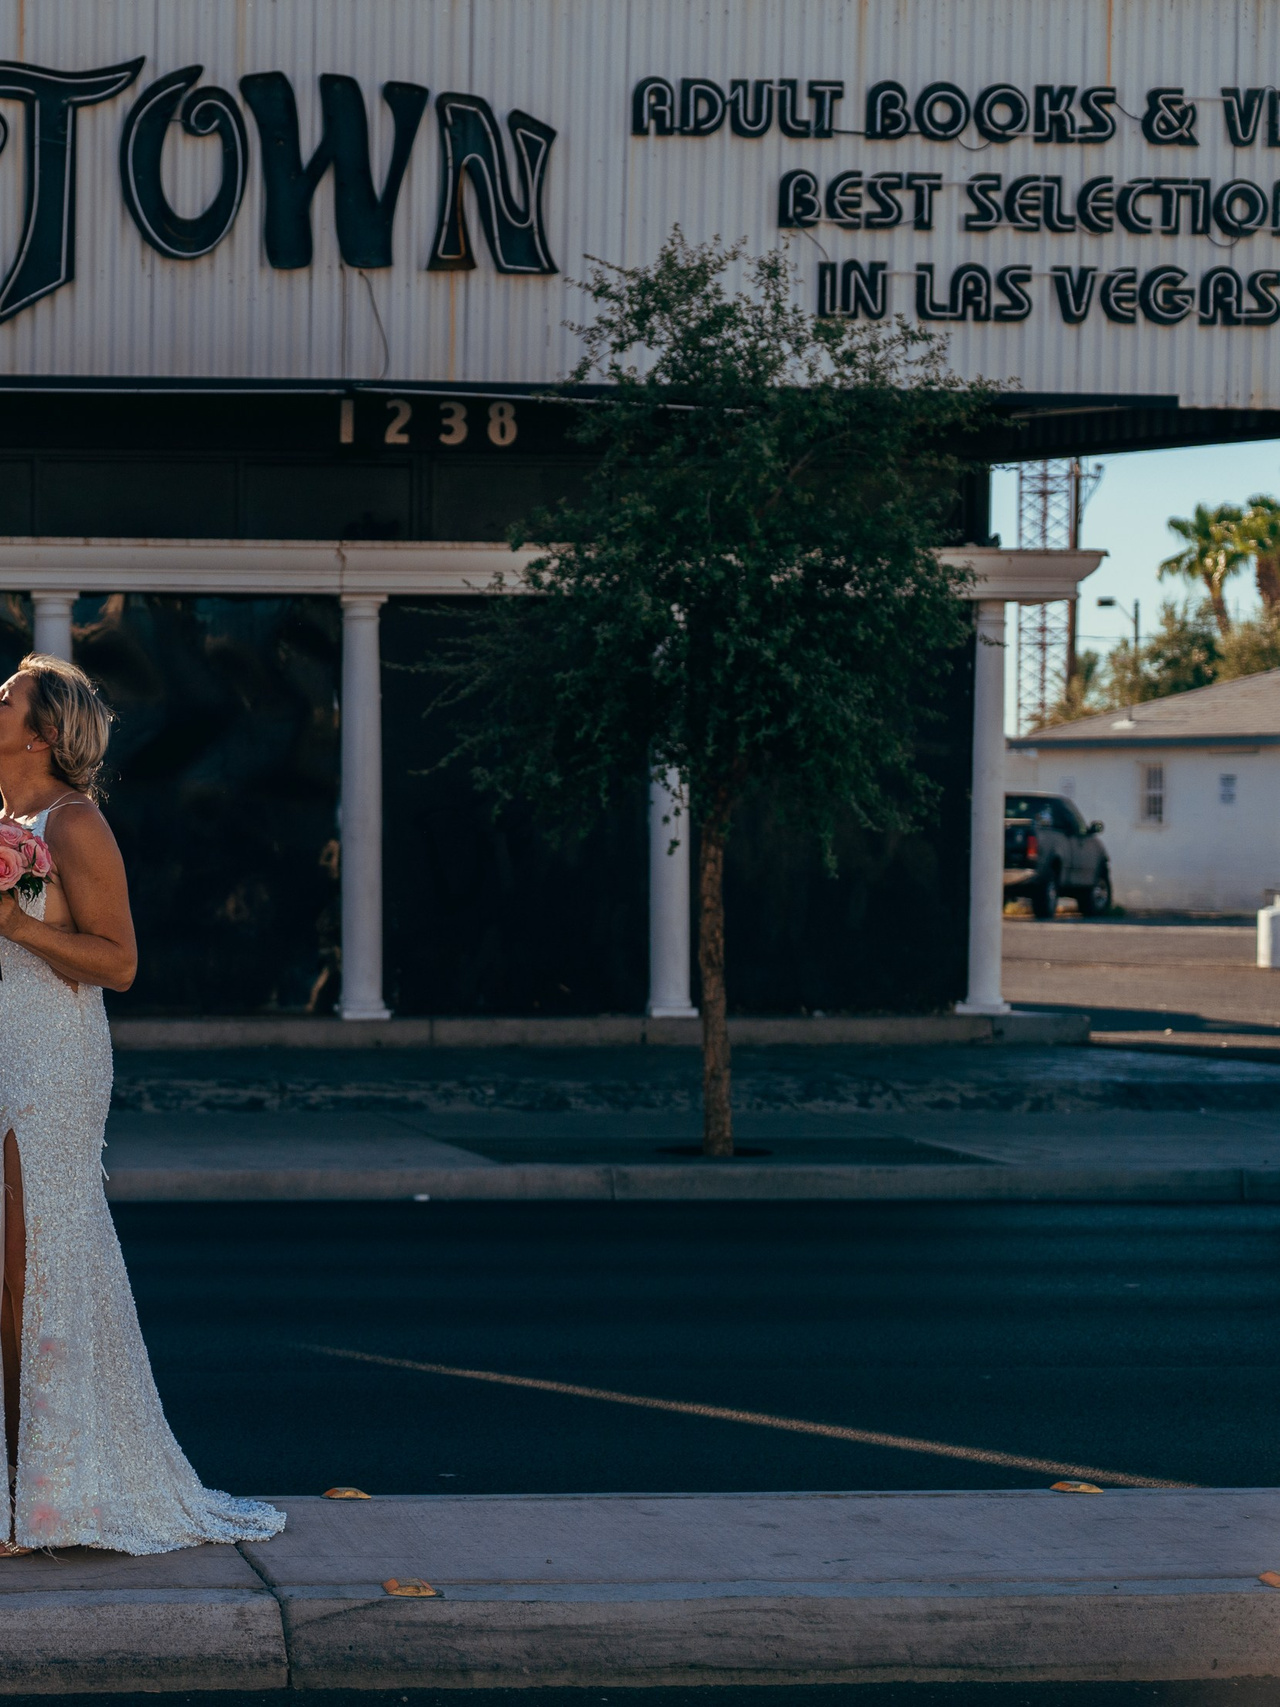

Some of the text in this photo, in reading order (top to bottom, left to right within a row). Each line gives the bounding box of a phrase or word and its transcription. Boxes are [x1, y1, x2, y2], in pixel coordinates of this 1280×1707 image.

[631, 76, 844, 138] ADULT
[866, 80, 1116, 144] BOOKS
[1141, 87, 1200, 146] &
[778, 168, 1280, 238] BEST SELECTIO
[818, 259, 1280, 326] IN LAS VEGAS
[339, 400, 518, 446] 1238
